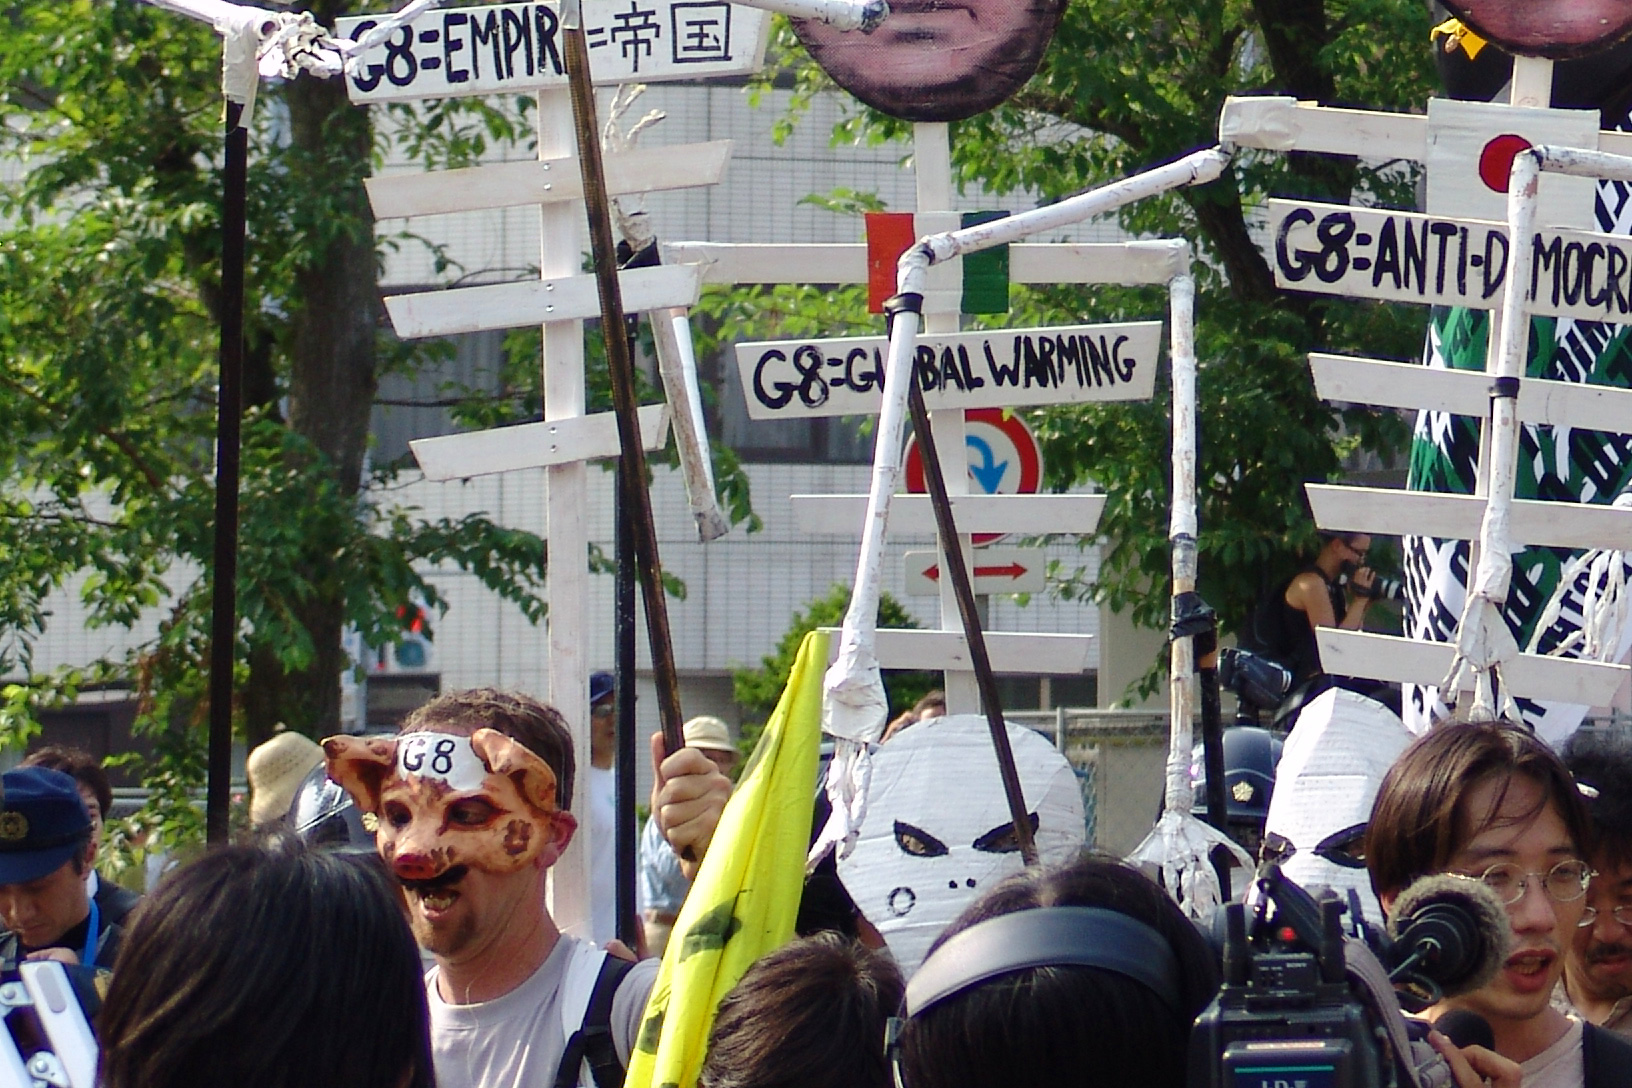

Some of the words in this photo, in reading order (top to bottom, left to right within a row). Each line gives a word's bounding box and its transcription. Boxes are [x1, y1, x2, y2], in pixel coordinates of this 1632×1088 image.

[348, 1, 732, 92] G8=EMPIR=帝国
[753, 344, 984, 409] G8=GLBAL
[983, 335, 1136, 389] WARMING
[403, 738, 456, 775] G8
